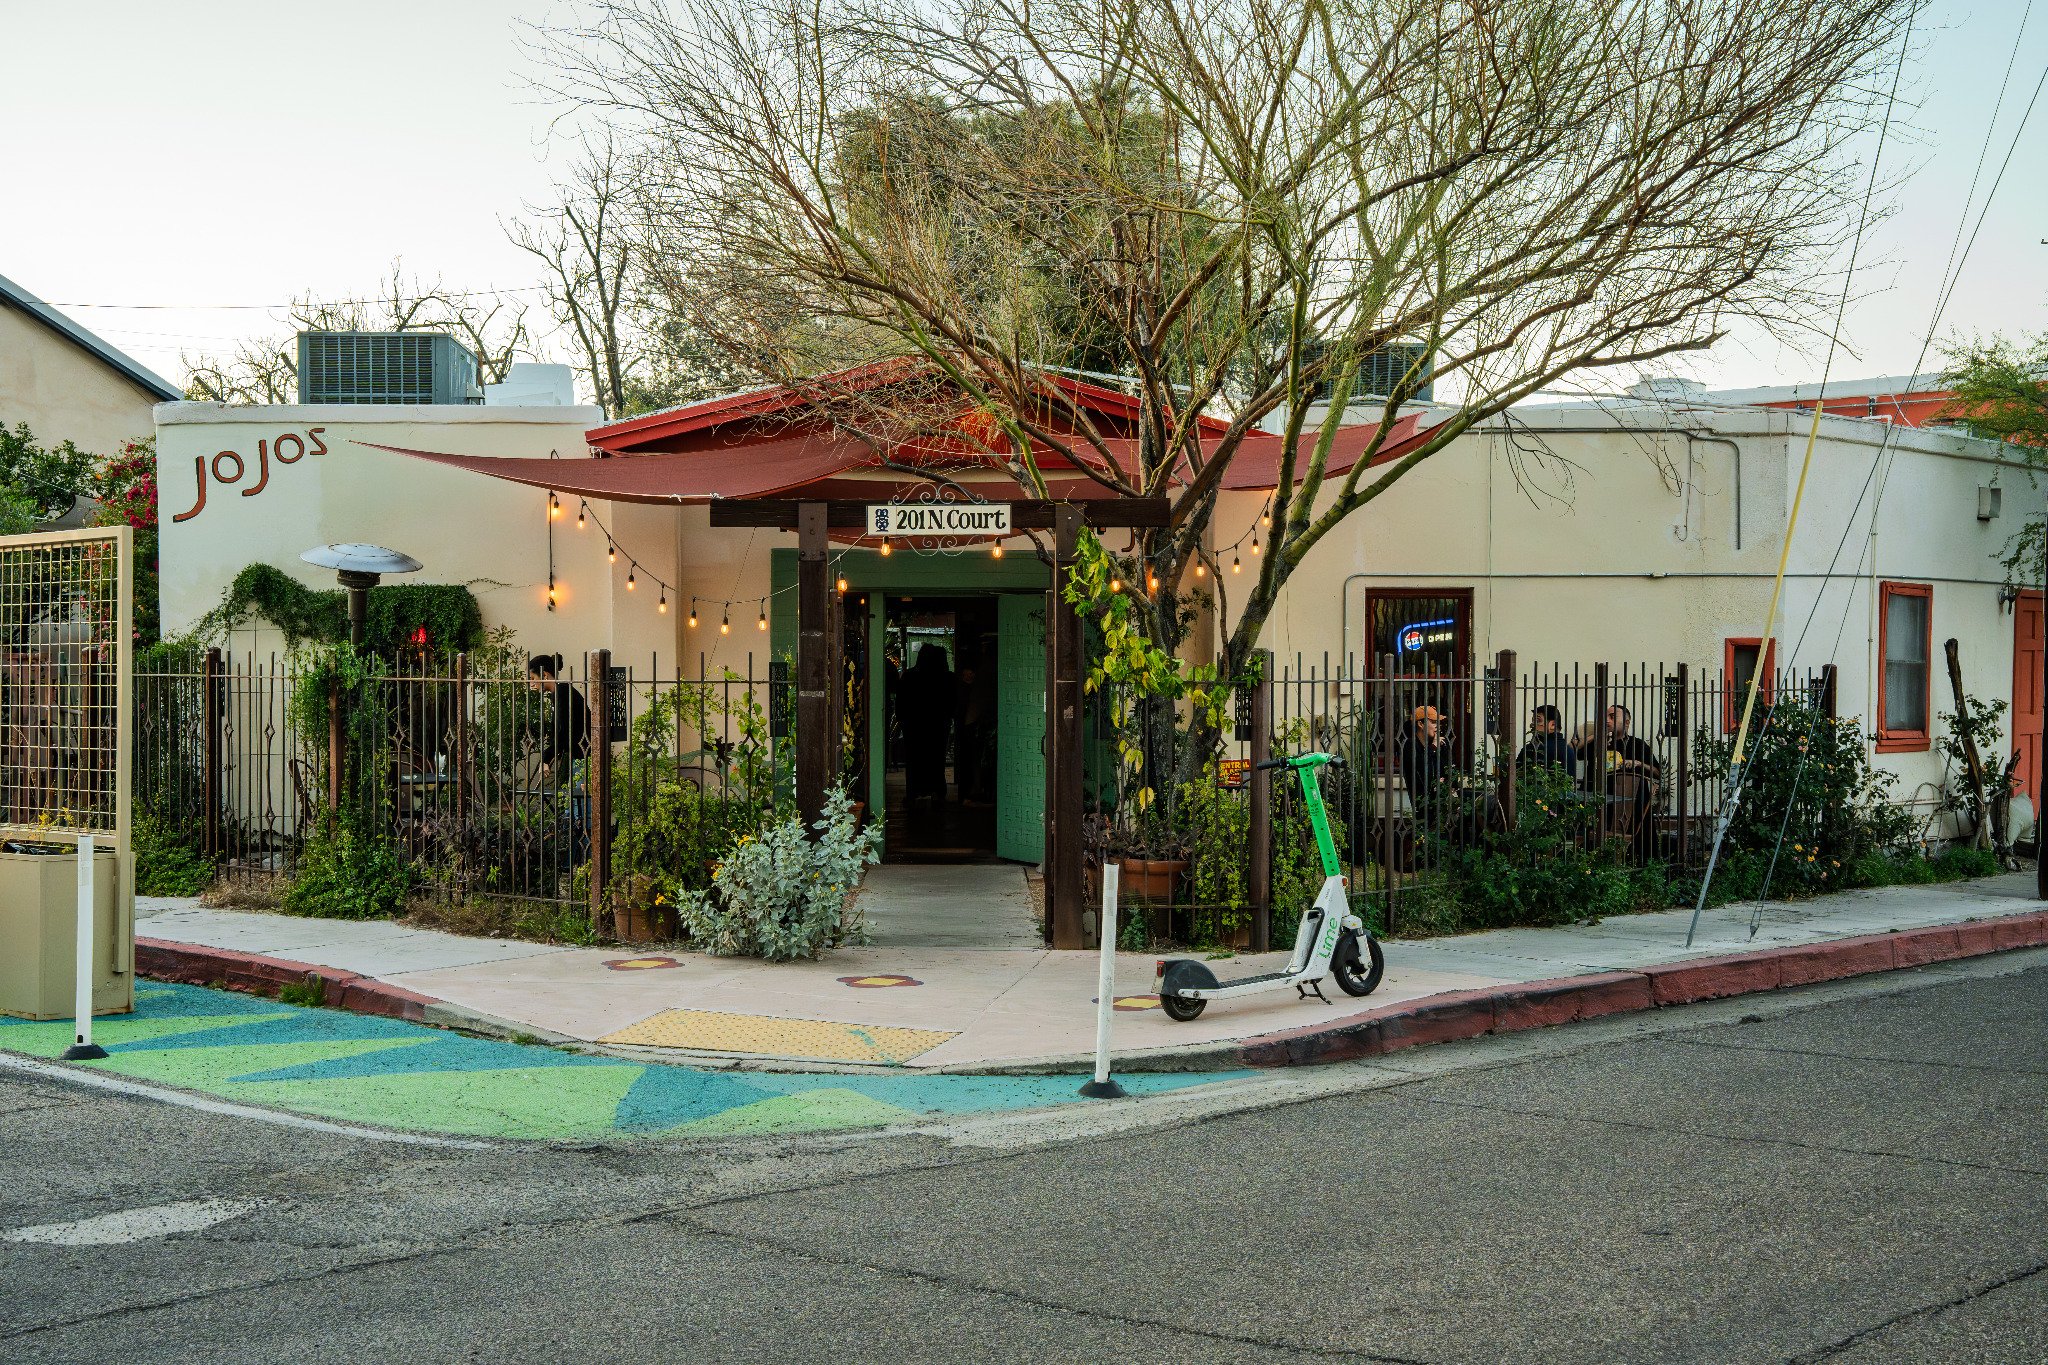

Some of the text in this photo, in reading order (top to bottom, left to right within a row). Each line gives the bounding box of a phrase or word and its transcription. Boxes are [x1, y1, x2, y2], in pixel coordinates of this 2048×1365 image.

[896, 509, 1006, 530] 201 N. Court
[1428, 632, 1453, 643] OPEN
[1317, 918, 1338, 959] Lime
